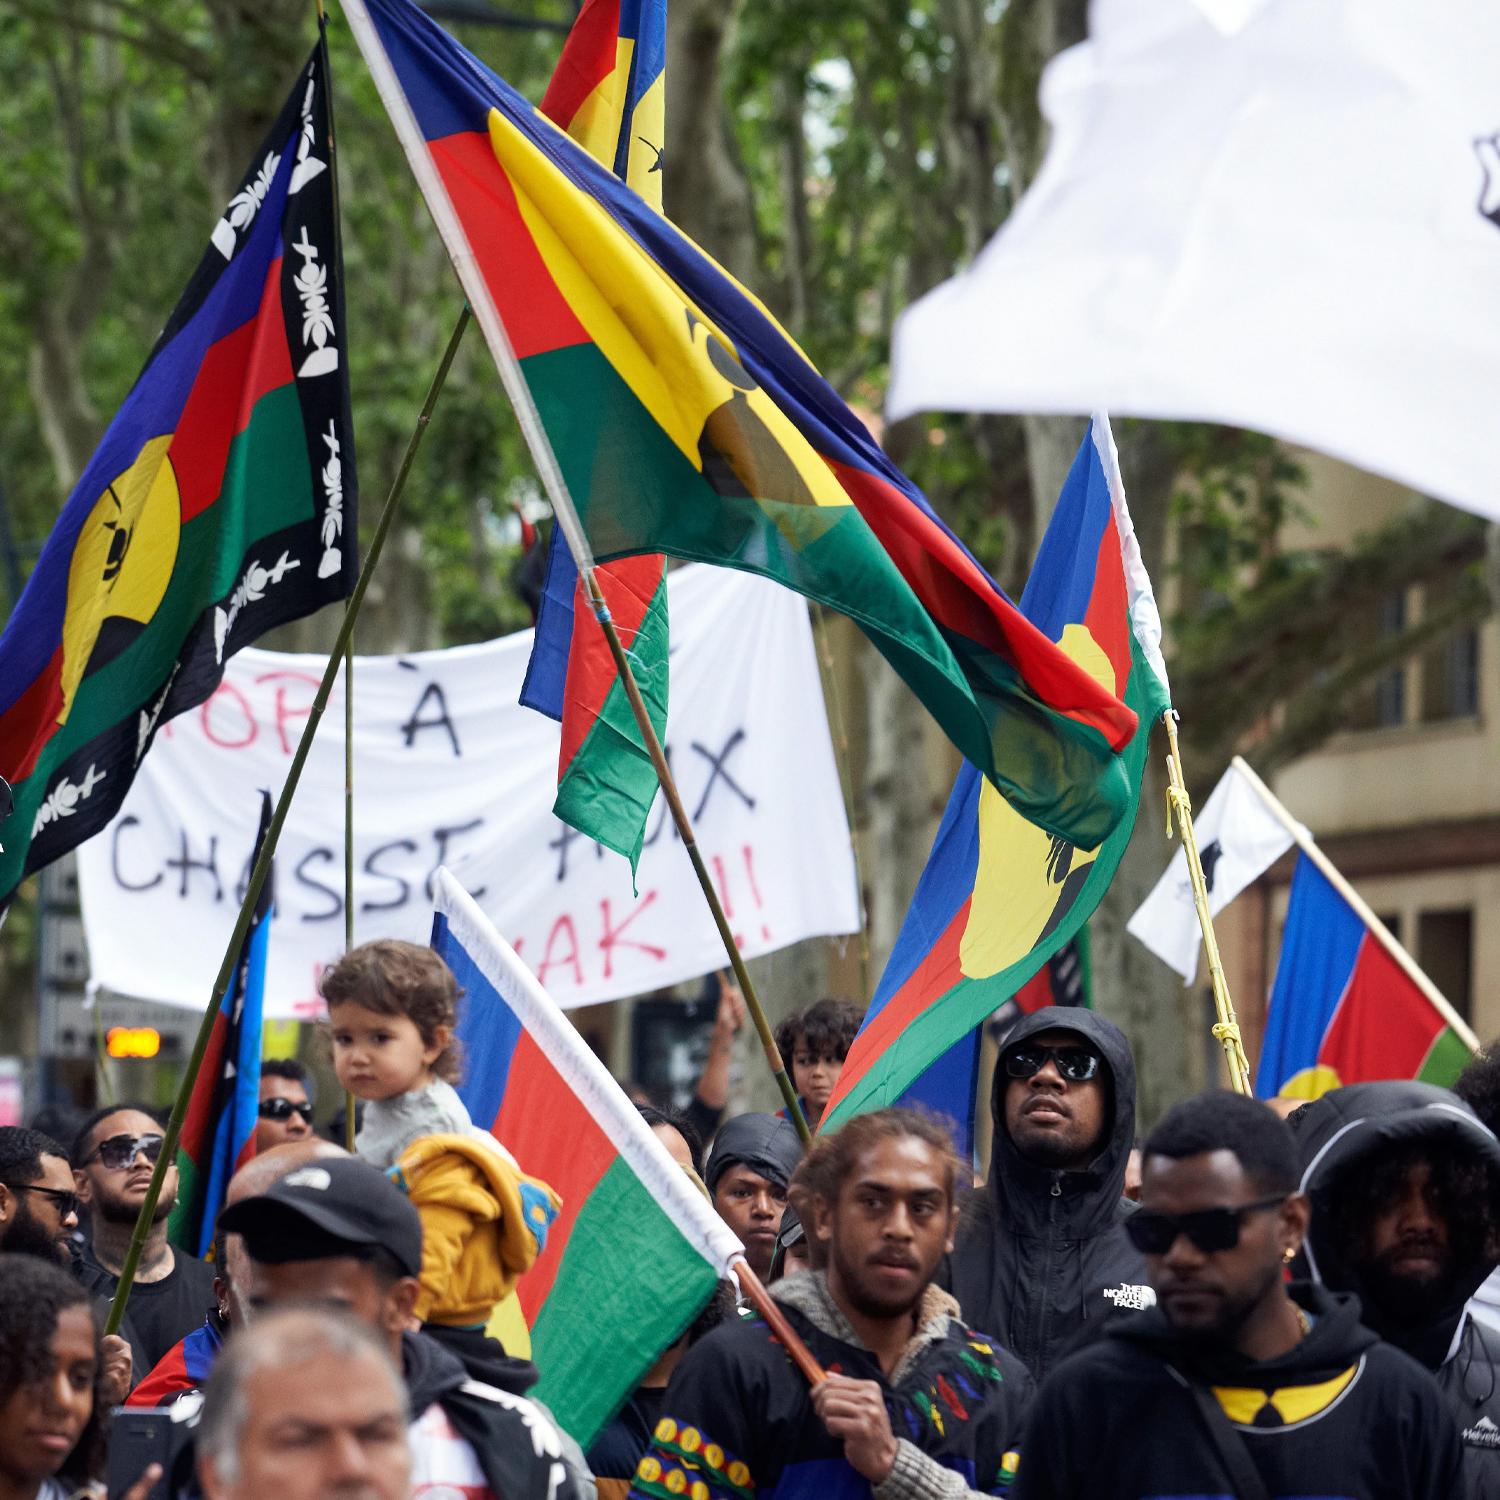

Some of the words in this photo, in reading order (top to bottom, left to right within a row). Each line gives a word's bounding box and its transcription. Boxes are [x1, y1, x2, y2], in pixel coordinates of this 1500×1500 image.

[163, 671, 333, 755] OP
[397, 660, 463, 757] À
[1120, 1282, 1142, 1293] THE
[1103, 1288, 1142, 1301] NORTH
[1113, 1297, 1143, 1310] FACE
